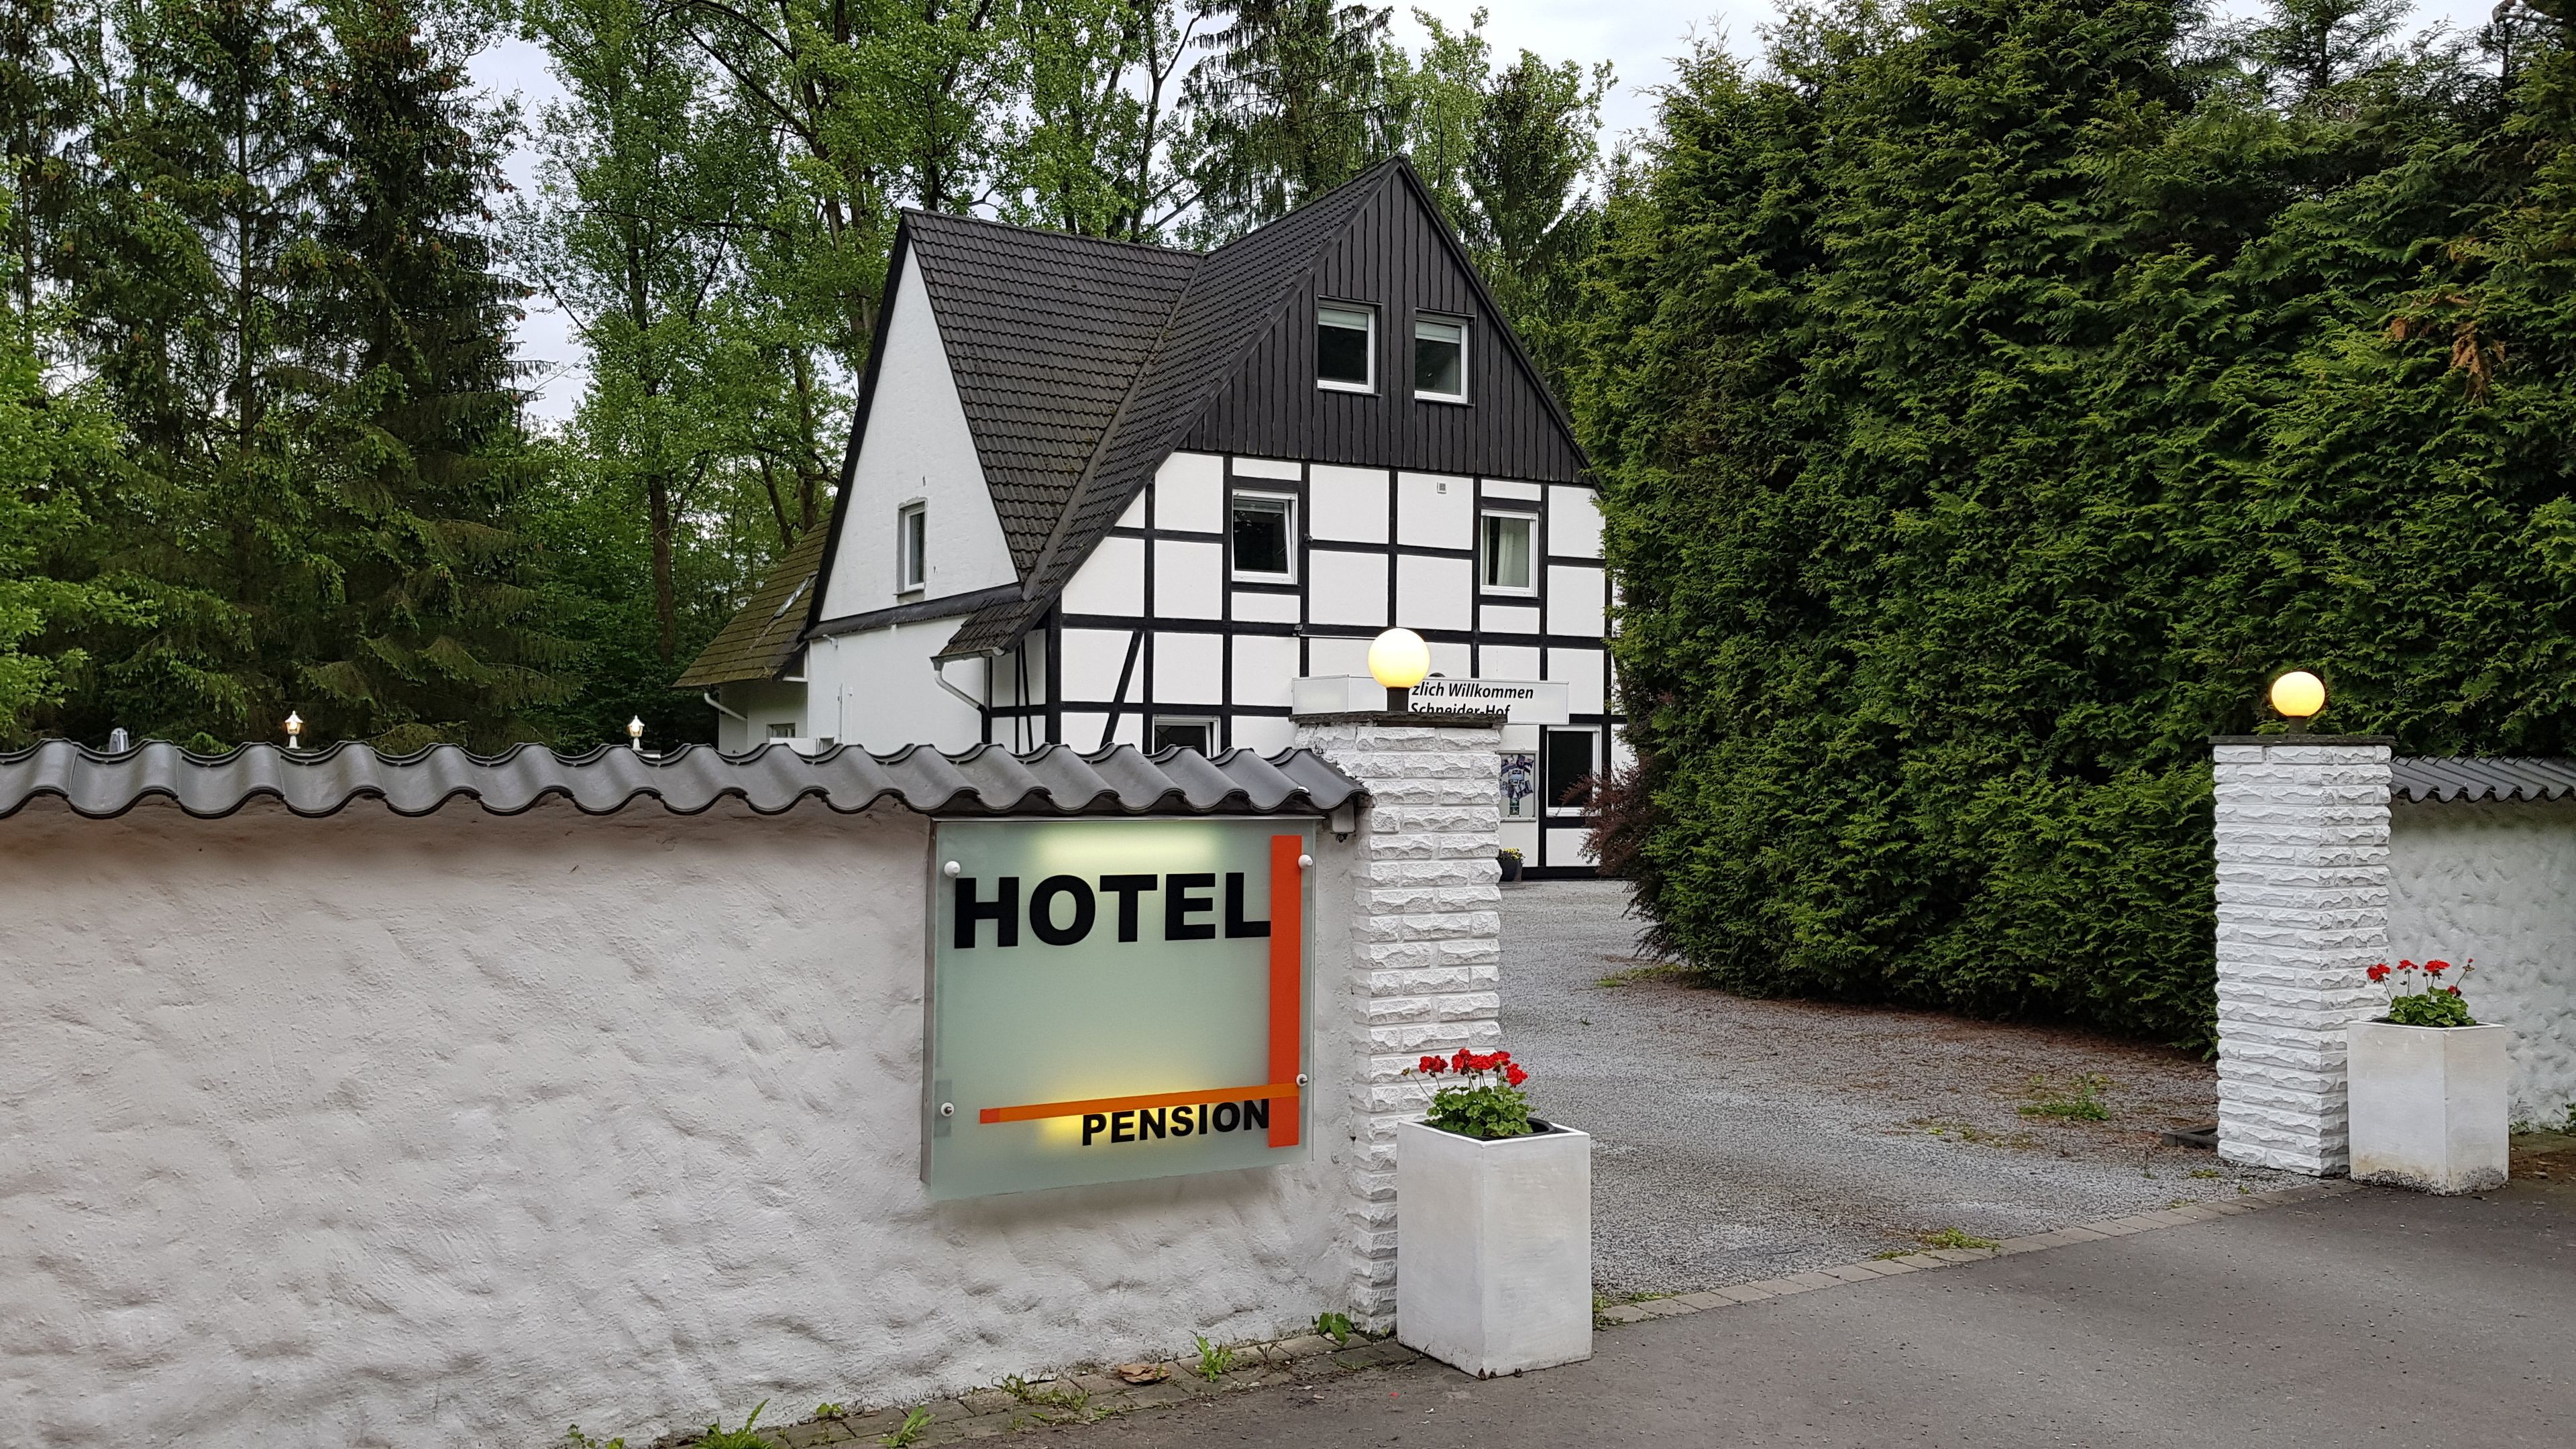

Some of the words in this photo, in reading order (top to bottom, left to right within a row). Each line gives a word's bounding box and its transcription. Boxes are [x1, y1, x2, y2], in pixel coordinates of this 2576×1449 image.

[1411, 682, 1444, 696] zlich
[1449, 683, 1534, 699] Willkommen
[1411, 702, 1511, 714] Schneider-Hof
[954, 872, 1272, 949] HOTEL
[1081, 1097, 1270, 1146] PENSION
